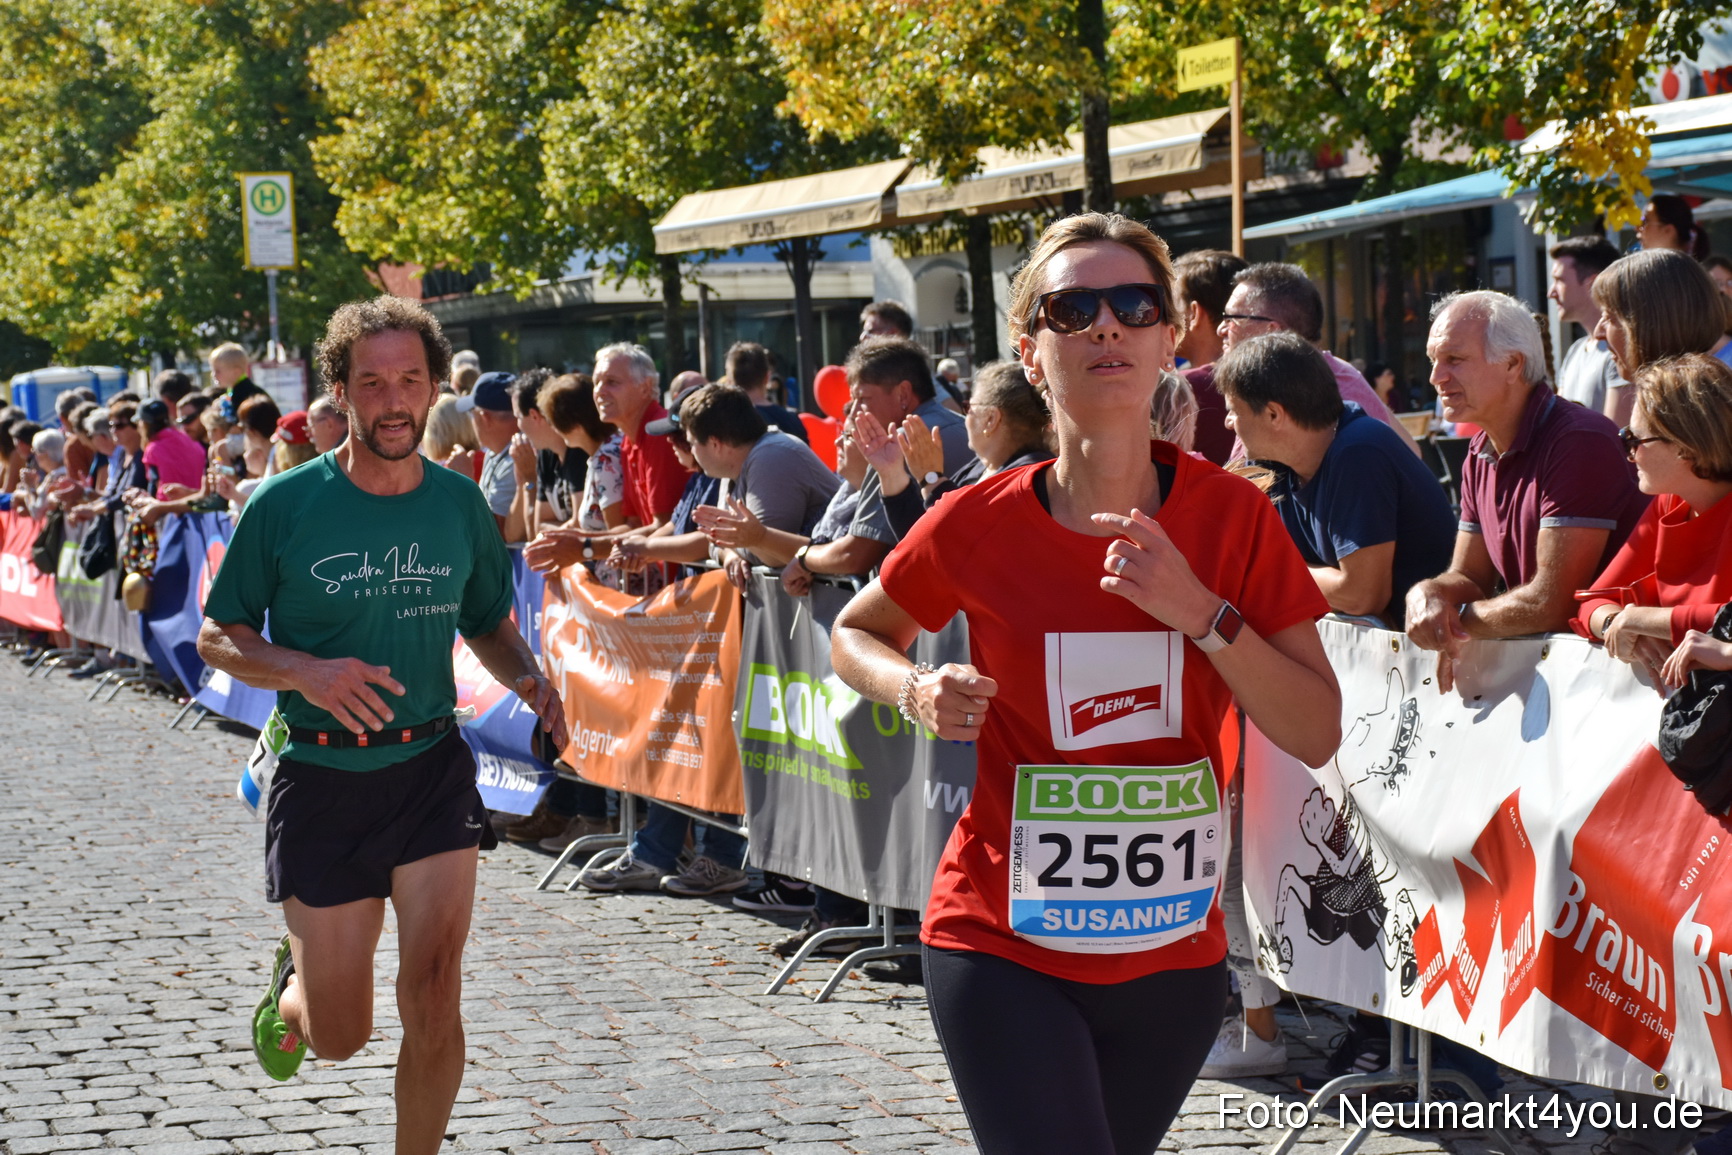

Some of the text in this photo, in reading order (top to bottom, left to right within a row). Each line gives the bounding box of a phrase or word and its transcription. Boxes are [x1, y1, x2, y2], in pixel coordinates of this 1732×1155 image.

[1189, 56, 1232, 76] Toiletten
[311, 542, 452, 594] Sandra Lehmeier
[354, 585, 432, 599] FRISEURE
[1093, 695, 1136, 719] DEHN
[1034, 774, 1204, 812] BOCK
[1037, 829, 1195, 889] 2561
[1678, 835, 1720, 891] Seit 1929
[1042, 900, 1192, 932] SUSANNE
[1549, 869, 1667, 1013] Braun
[1585, 971, 1676, 1044] Sicher ist sicher
